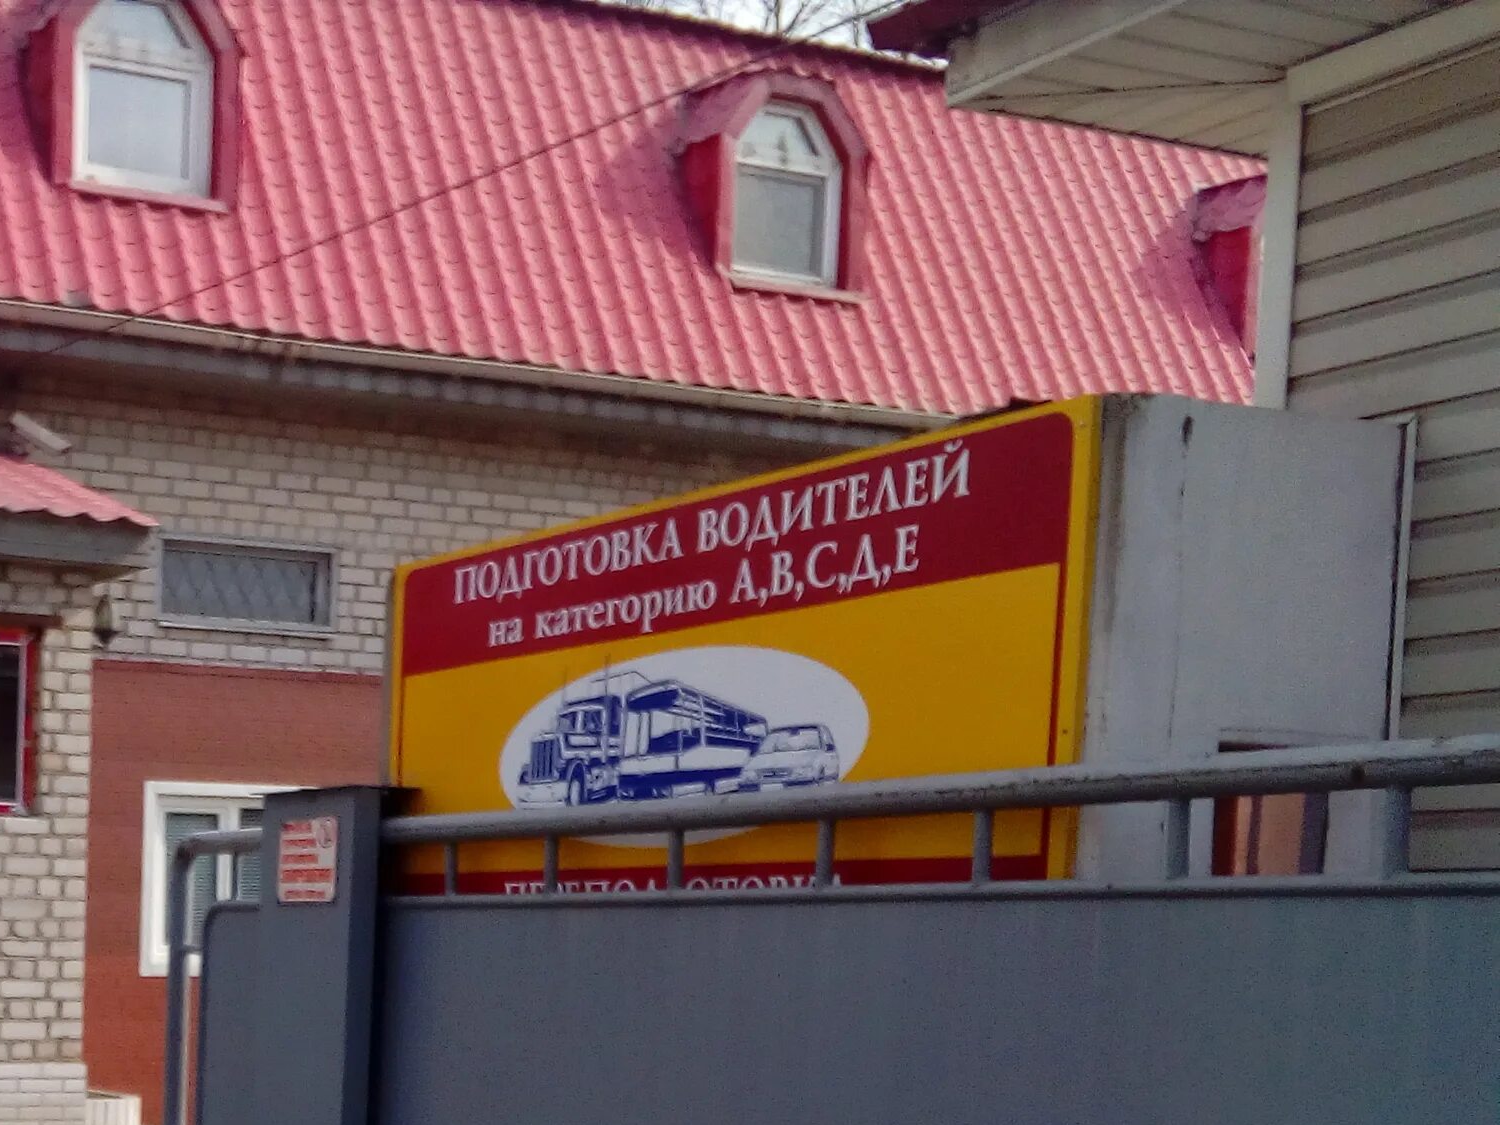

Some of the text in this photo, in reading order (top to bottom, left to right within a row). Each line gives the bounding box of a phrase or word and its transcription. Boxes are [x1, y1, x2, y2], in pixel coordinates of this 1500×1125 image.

[453, 438, 971, 604] ПОДГОТОВКА ВОДИТЕЛЕЙ
[487, 617, 525, 648] на
[534, 579, 718, 634] категорию
